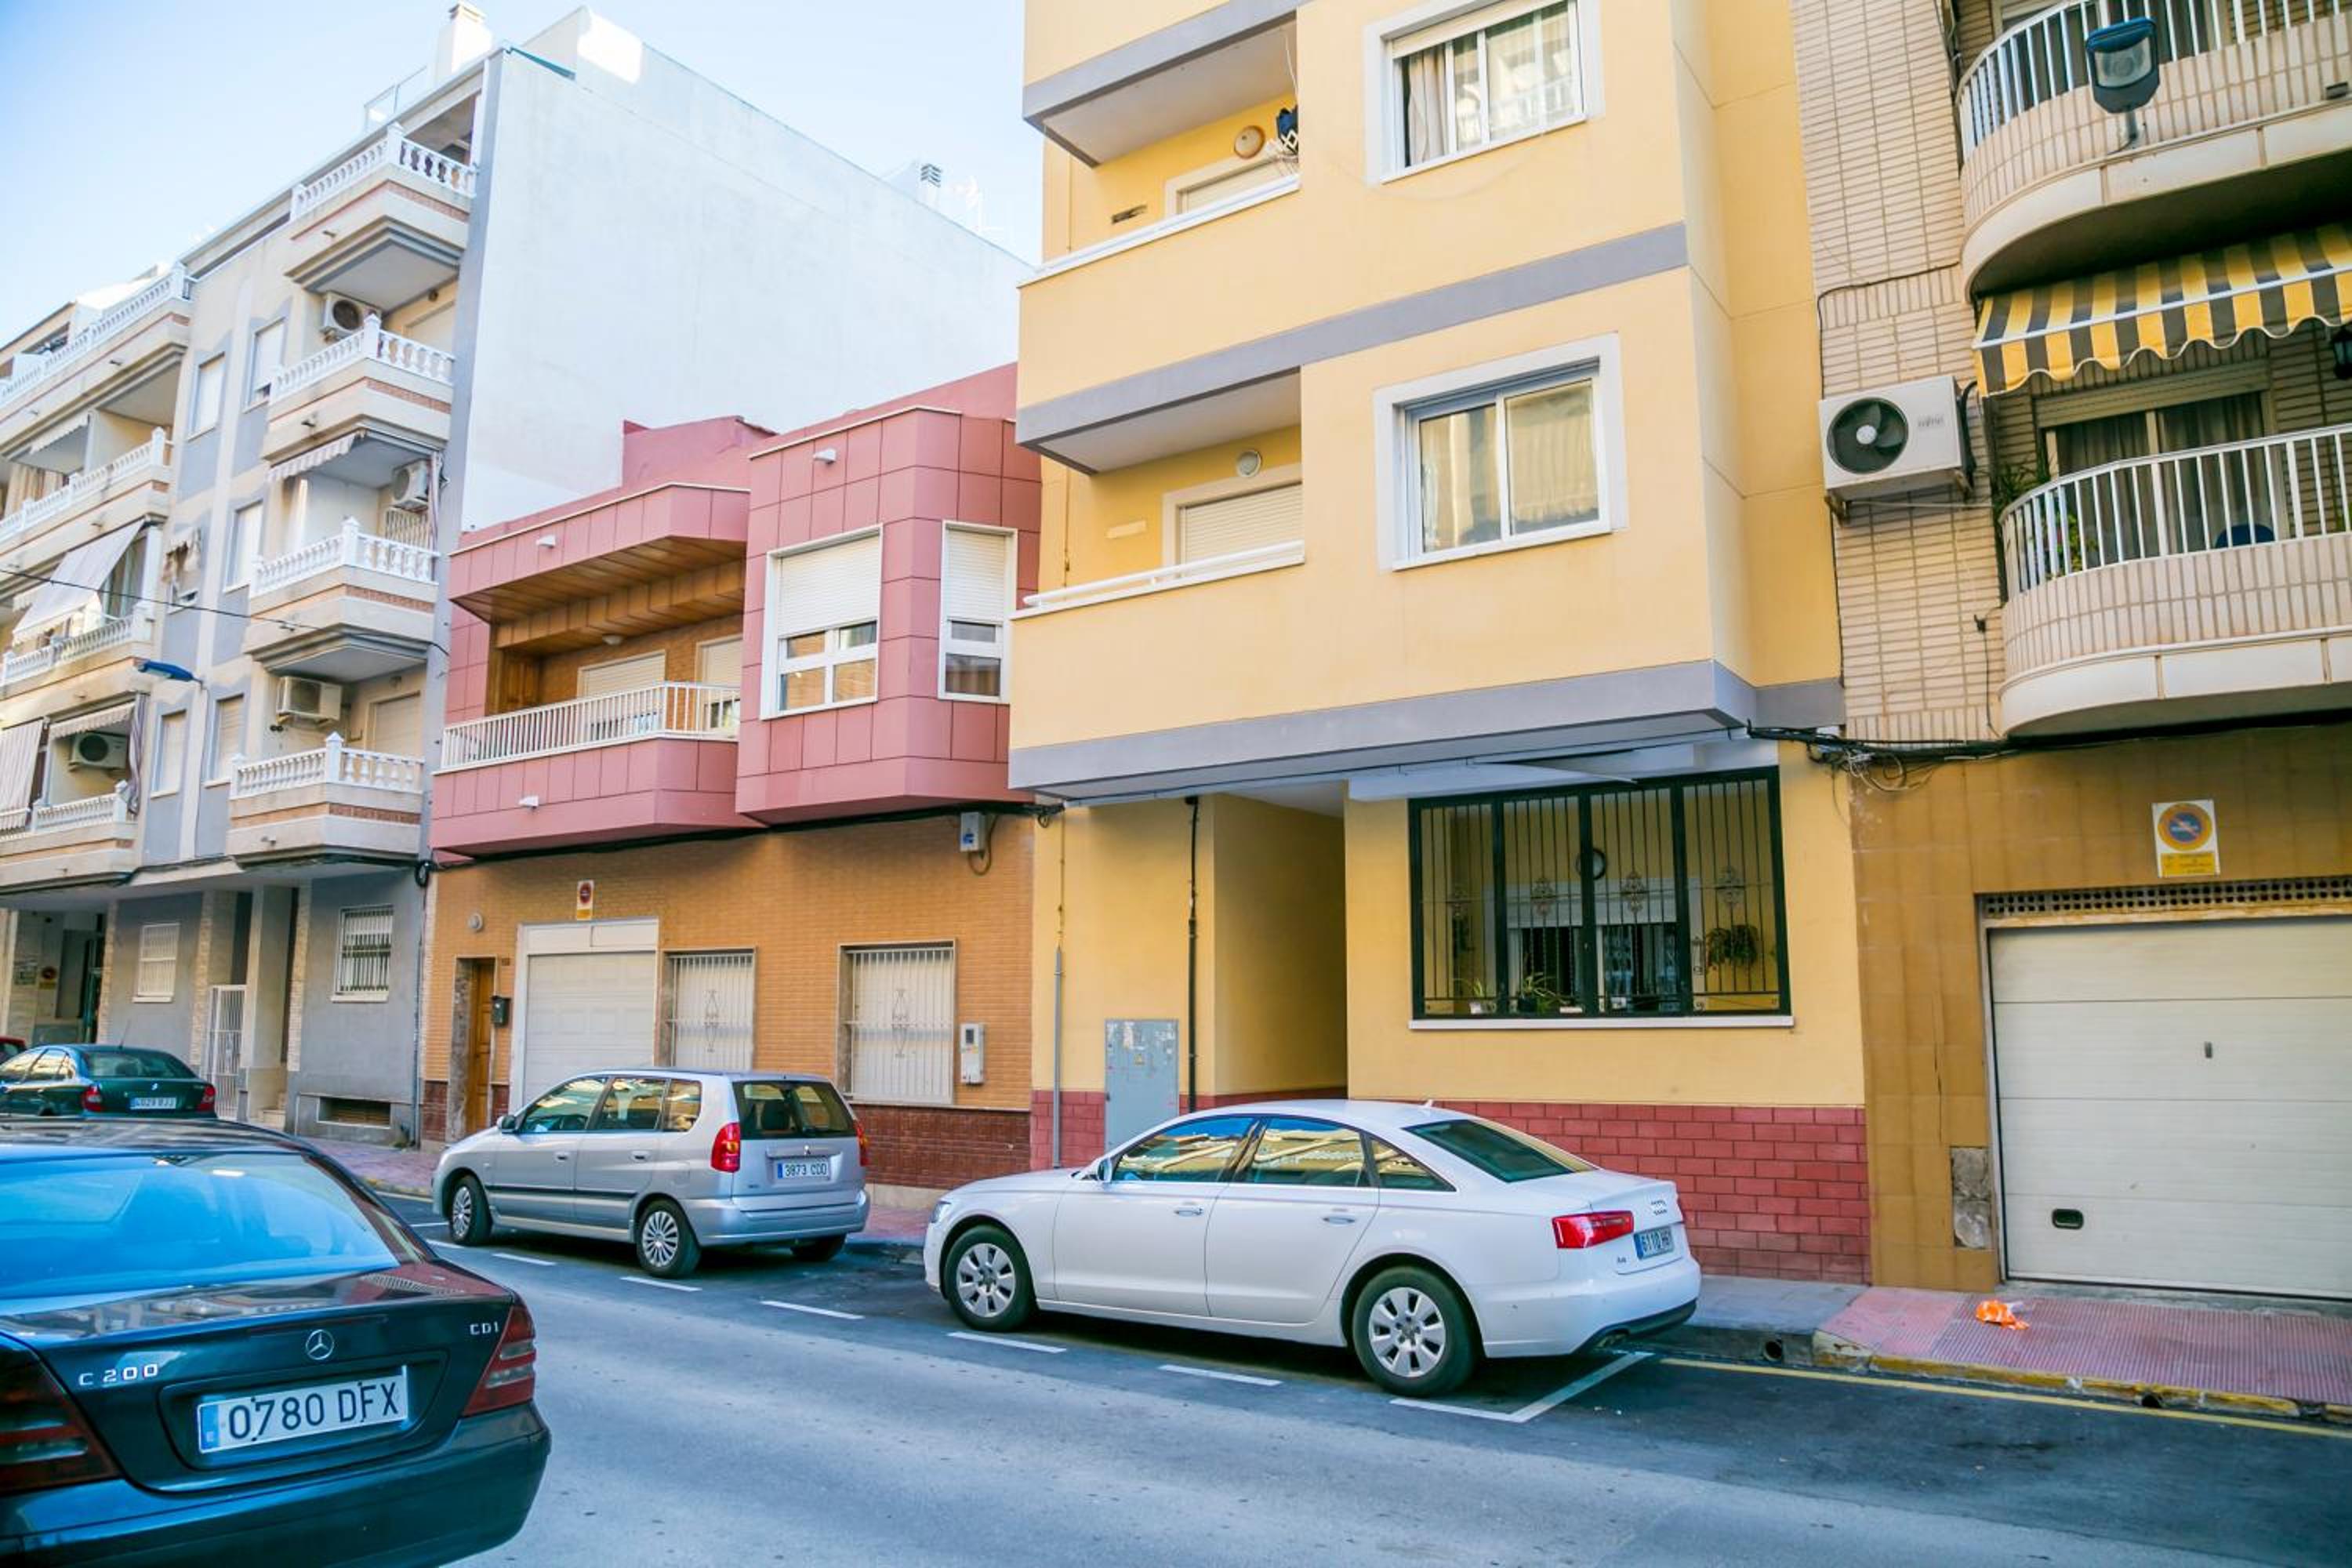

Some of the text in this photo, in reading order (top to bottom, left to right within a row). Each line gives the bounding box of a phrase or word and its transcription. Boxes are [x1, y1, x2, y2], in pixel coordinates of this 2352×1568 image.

[470, 1321, 499, 1335] CDI
[78, 1363, 158, 1386] C 200
[228, 1382, 398, 1439] 0780 DFX
